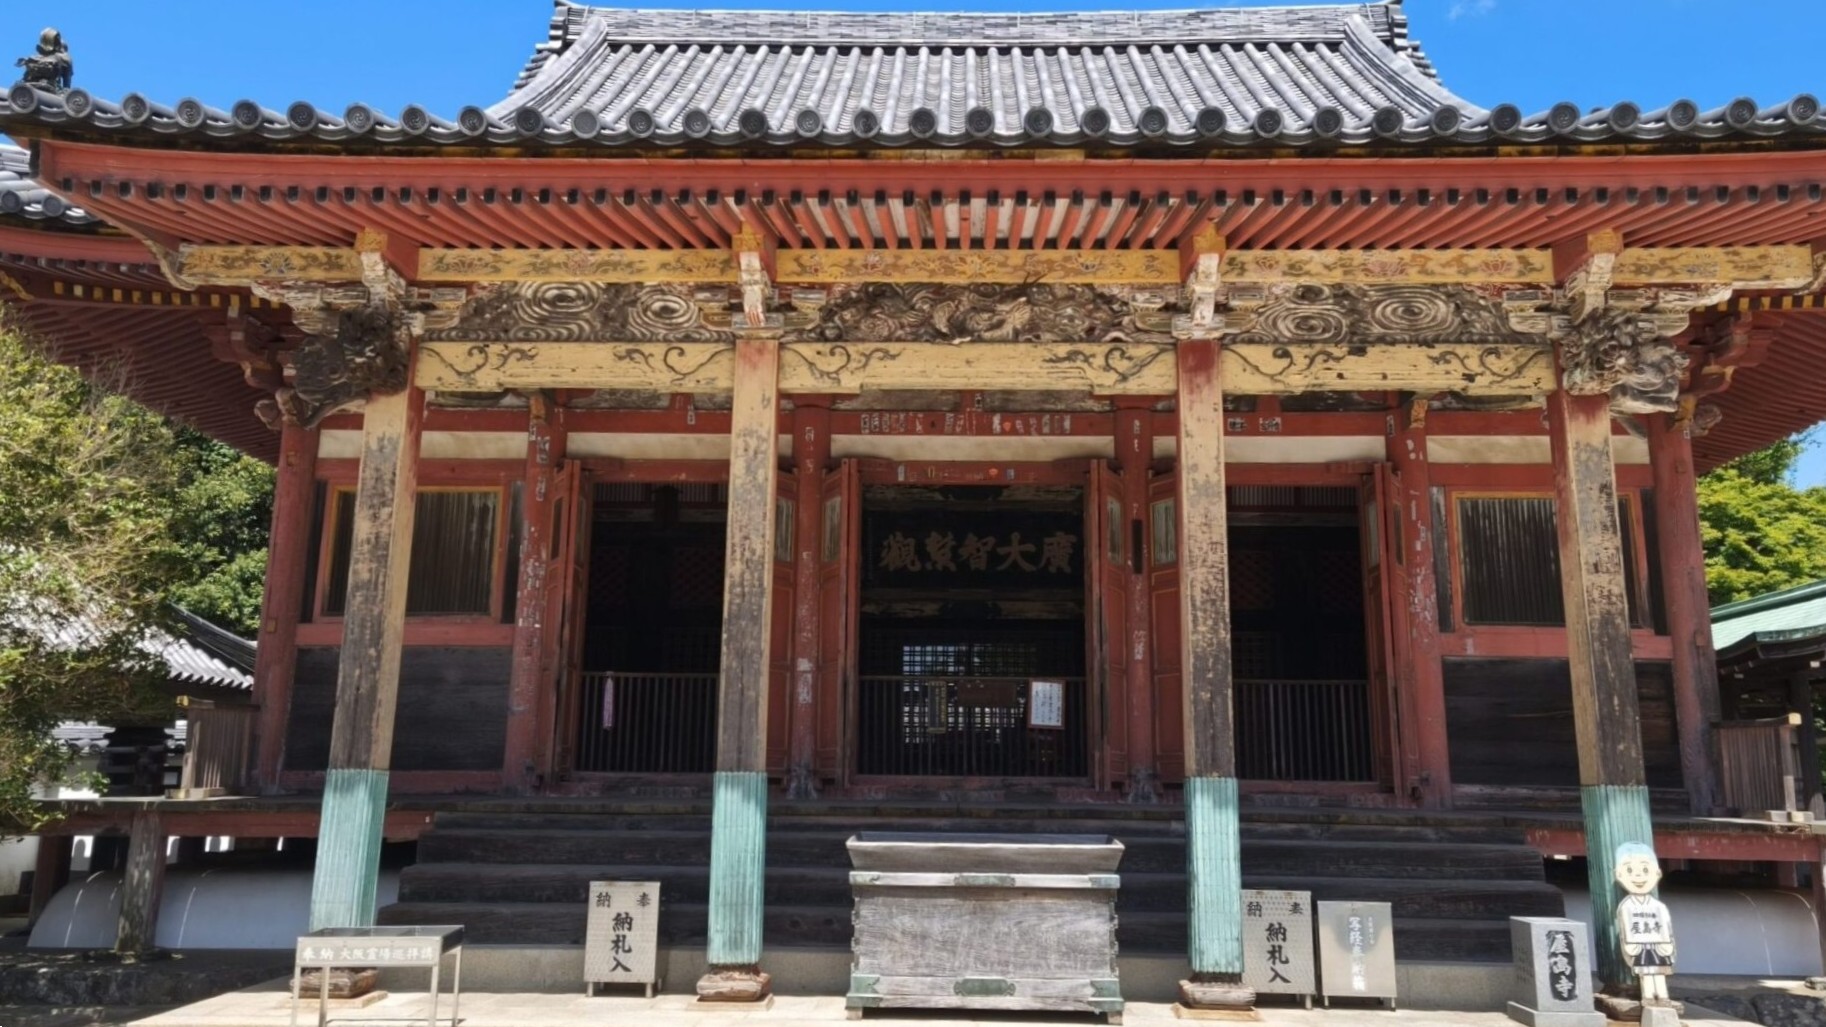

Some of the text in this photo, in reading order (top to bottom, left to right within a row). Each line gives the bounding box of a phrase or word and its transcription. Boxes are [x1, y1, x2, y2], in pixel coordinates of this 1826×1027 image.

[609, 911, 634, 973] 納札入
[1630, 920, 1663, 935] 屋島寺
[302, 946, 335, 962] 奉納
[1265, 922, 1292, 984] 納札入
